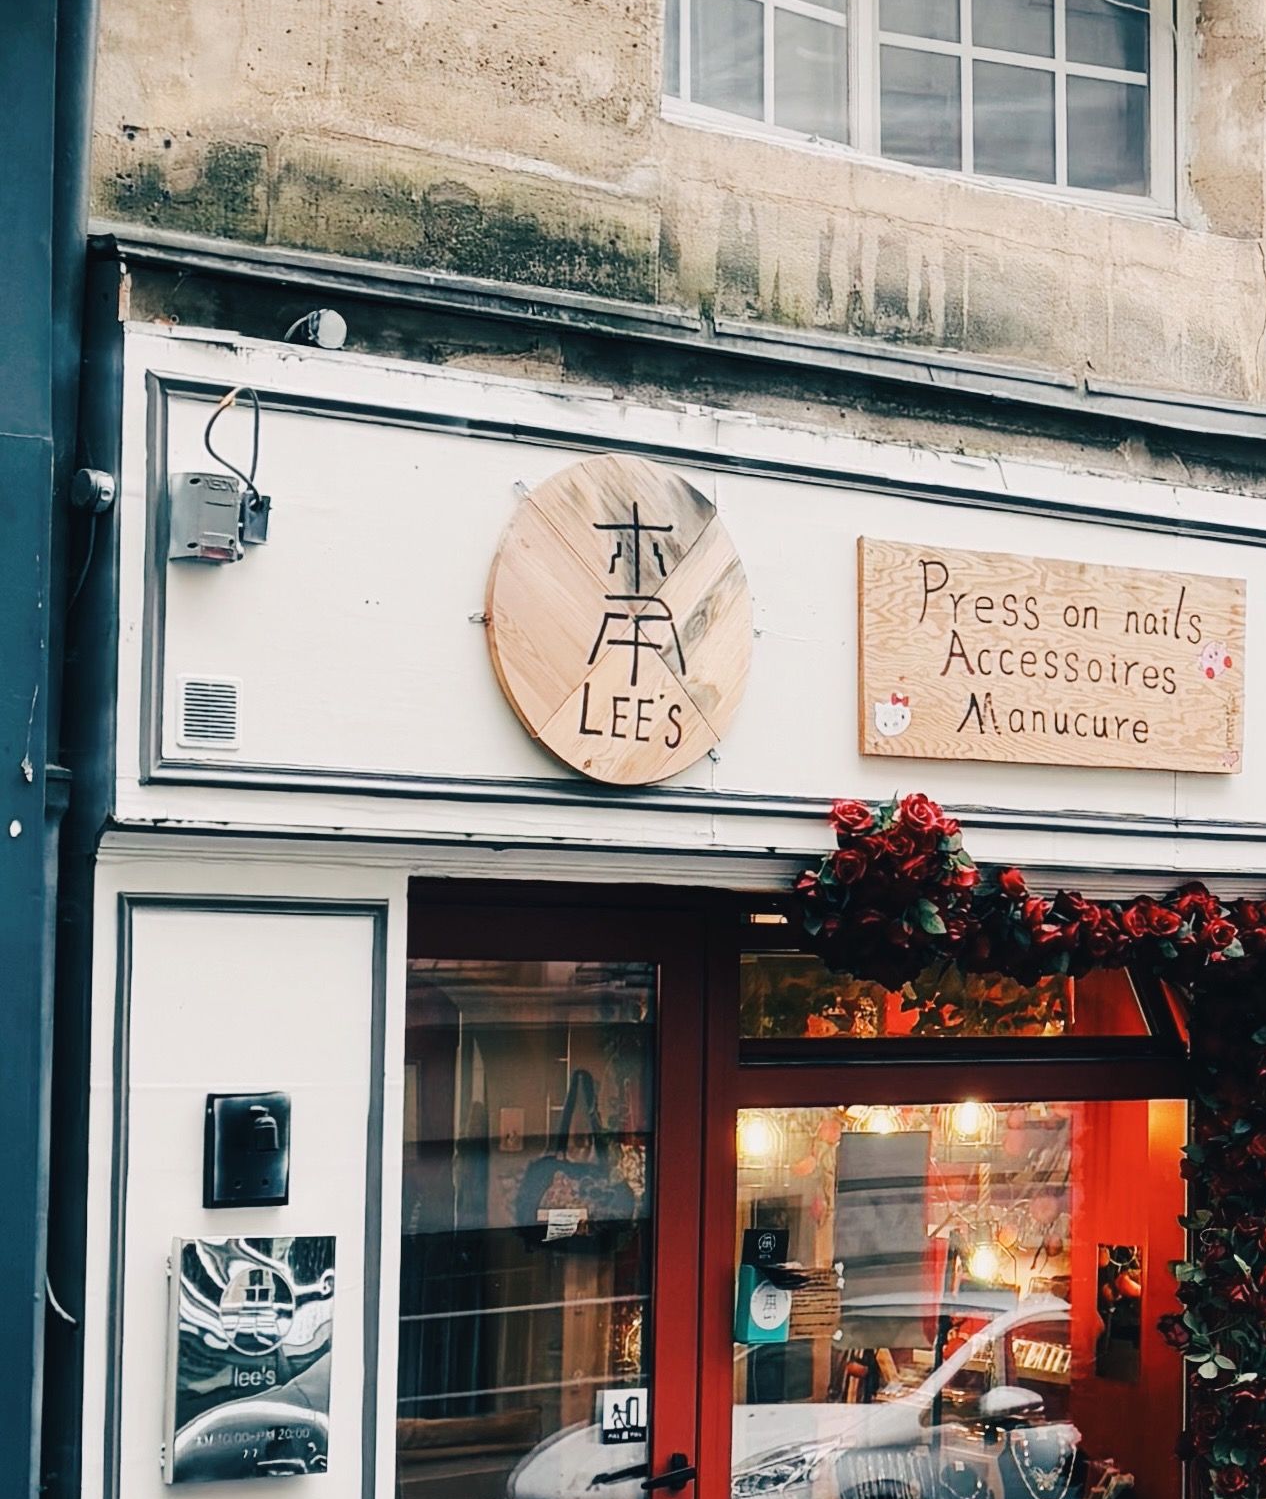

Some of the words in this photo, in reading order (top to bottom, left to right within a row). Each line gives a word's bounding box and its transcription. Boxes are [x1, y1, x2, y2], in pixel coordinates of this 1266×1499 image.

[919, 560, 1040, 631] Press
[1063, 604, 1100, 629] on
[1124, 586, 1202, 644] nails
[940, 629, 1177, 694] Accessoires
[579, 682, 682, 749] LEE'S
[957, 692, 1149, 744] Manucure
[234, 1365, 276, 1387] lee's
